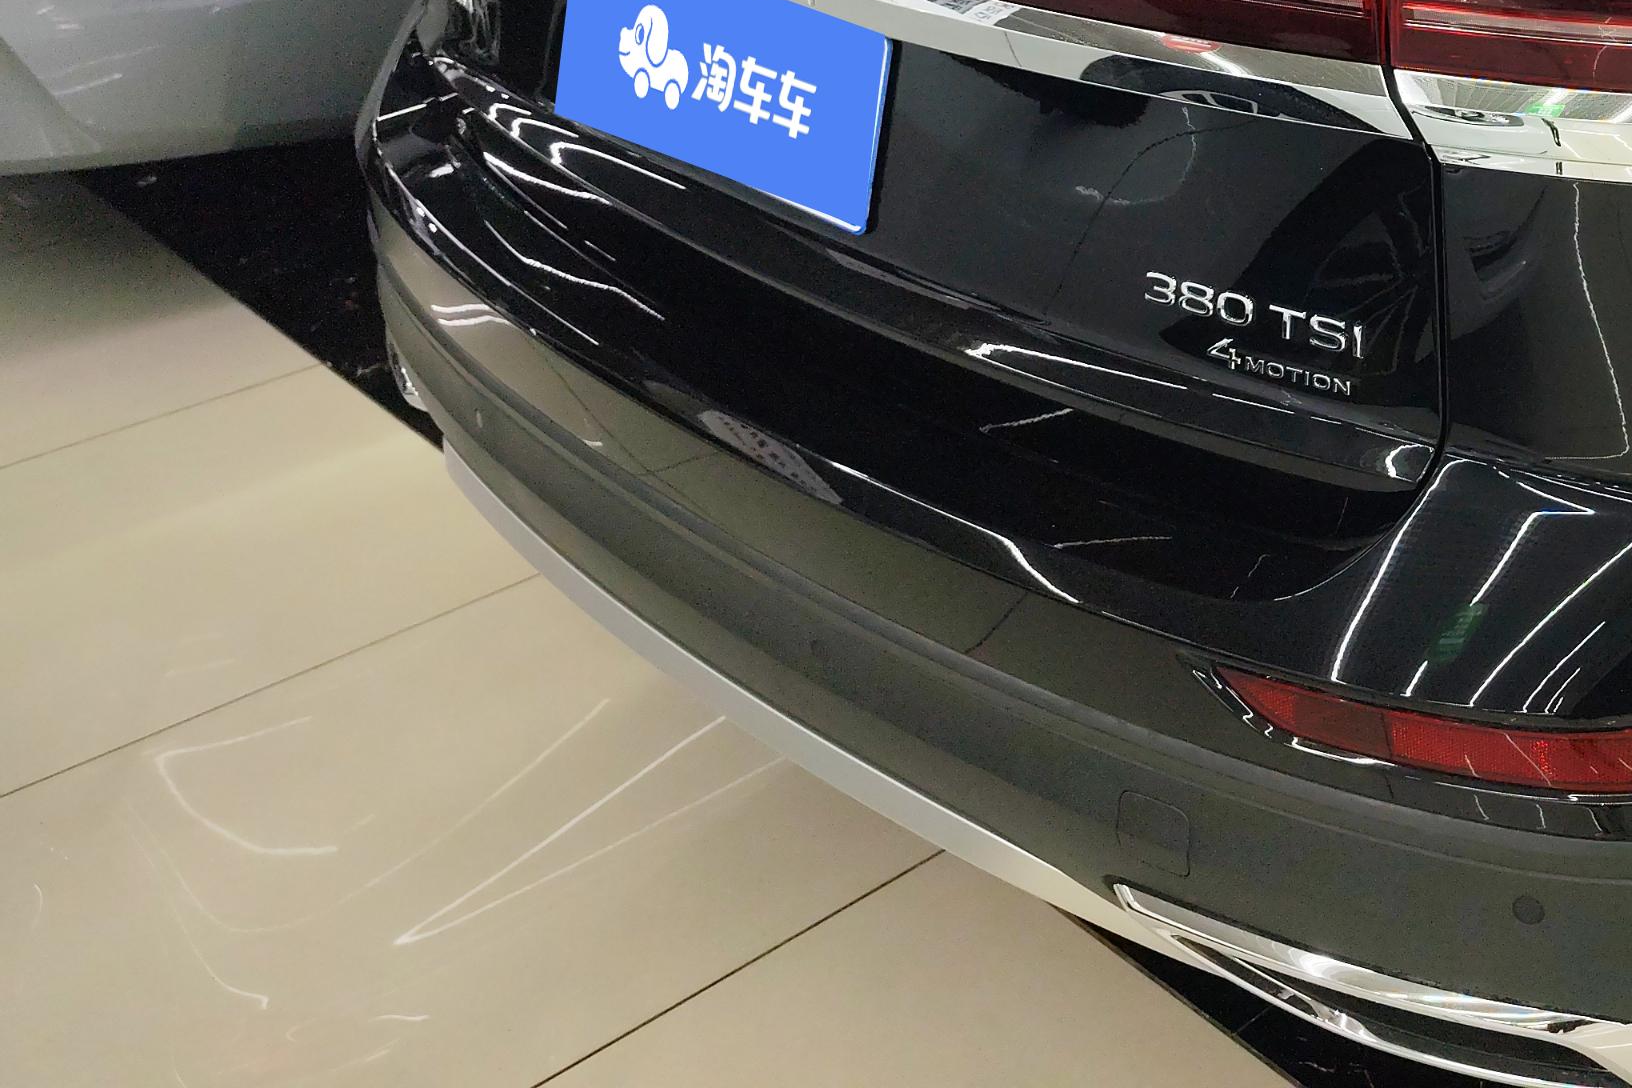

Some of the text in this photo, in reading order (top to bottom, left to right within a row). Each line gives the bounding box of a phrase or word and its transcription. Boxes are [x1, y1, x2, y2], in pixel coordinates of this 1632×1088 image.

[1145, 271, 1365, 359] 380 TSI
[1207, 338, 1351, 396] 4MOTION
